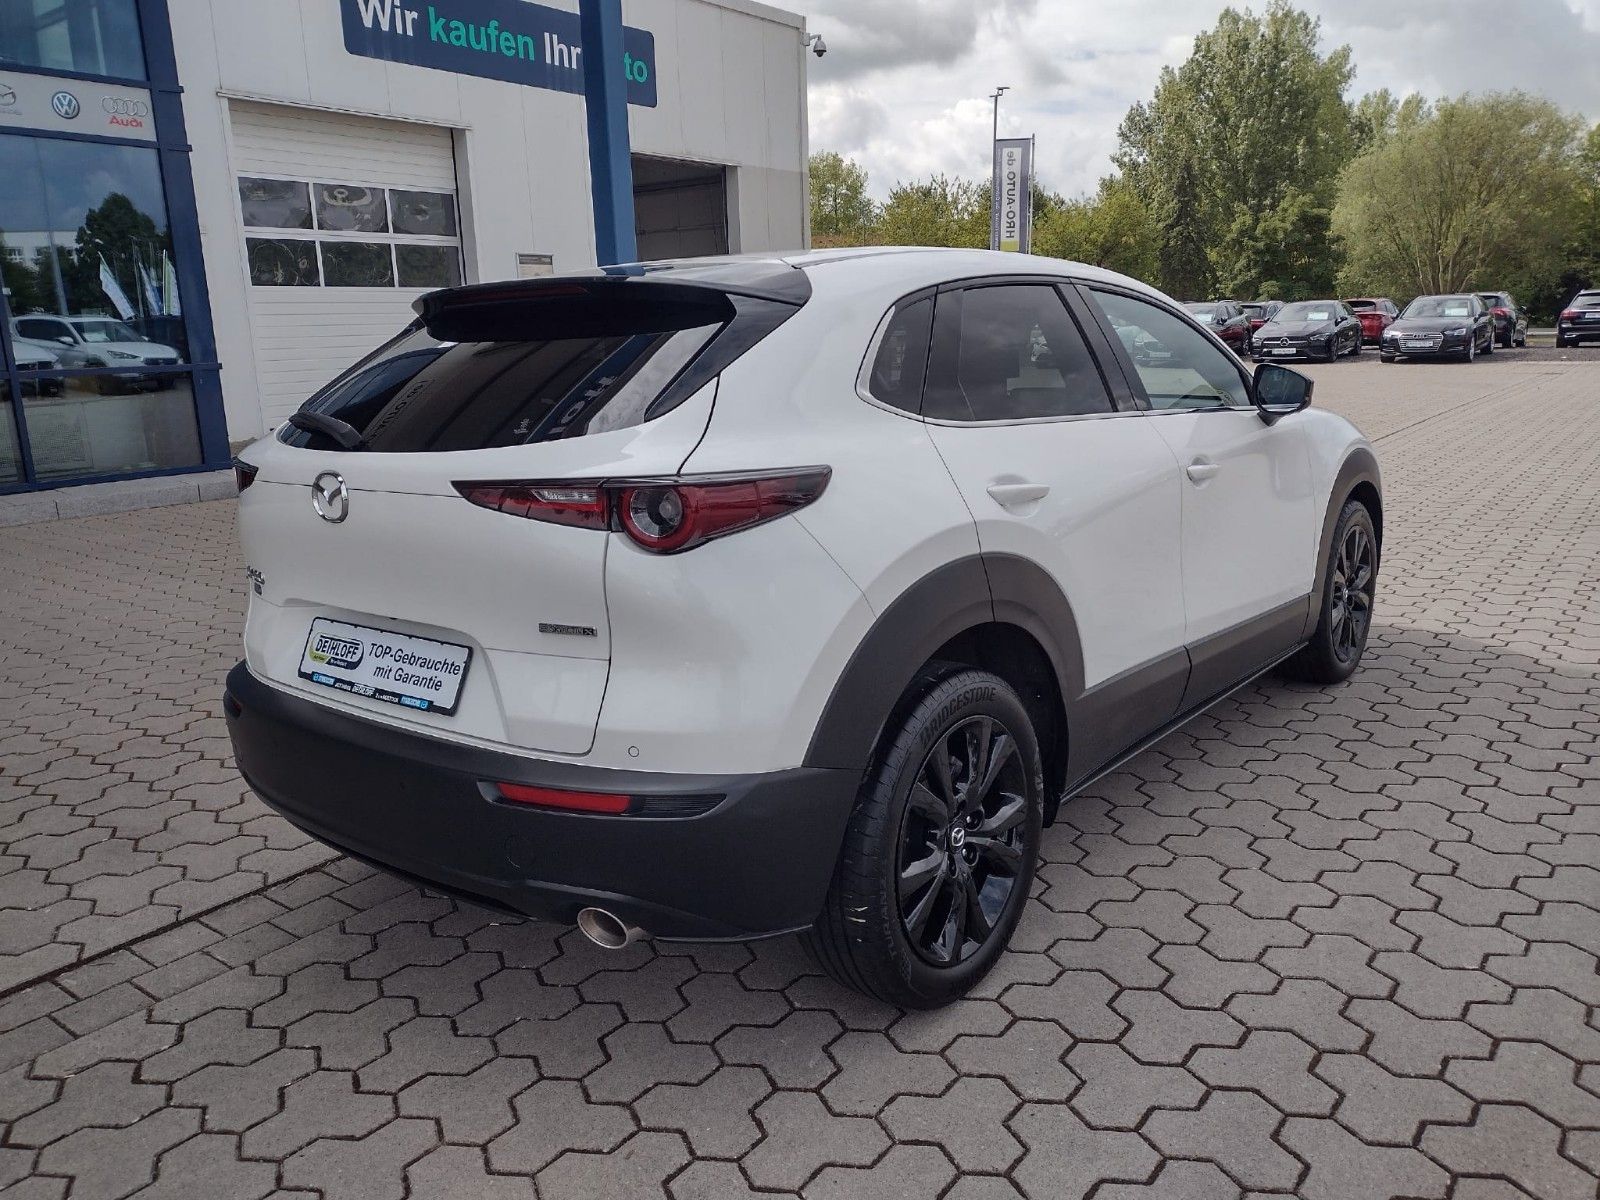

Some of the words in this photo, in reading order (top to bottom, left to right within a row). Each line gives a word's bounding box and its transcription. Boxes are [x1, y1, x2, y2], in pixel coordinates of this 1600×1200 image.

[356, 0, 418, 36] Wir
[428, 6, 535, 61] kaufen
[544, 32, 581, 69] Ihr
[624, 51, 649, 83] to
[109, 115, 143, 128] Audi
[316, 638, 359, 660] DEIHLOFF
[368, 643, 461, 676] TOP-Gebrauchte
[373, 665, 393, 679] mit
[394, 667, 443, 691] Garantie
[920, 686, 996, 750] BRIDGESTONE
